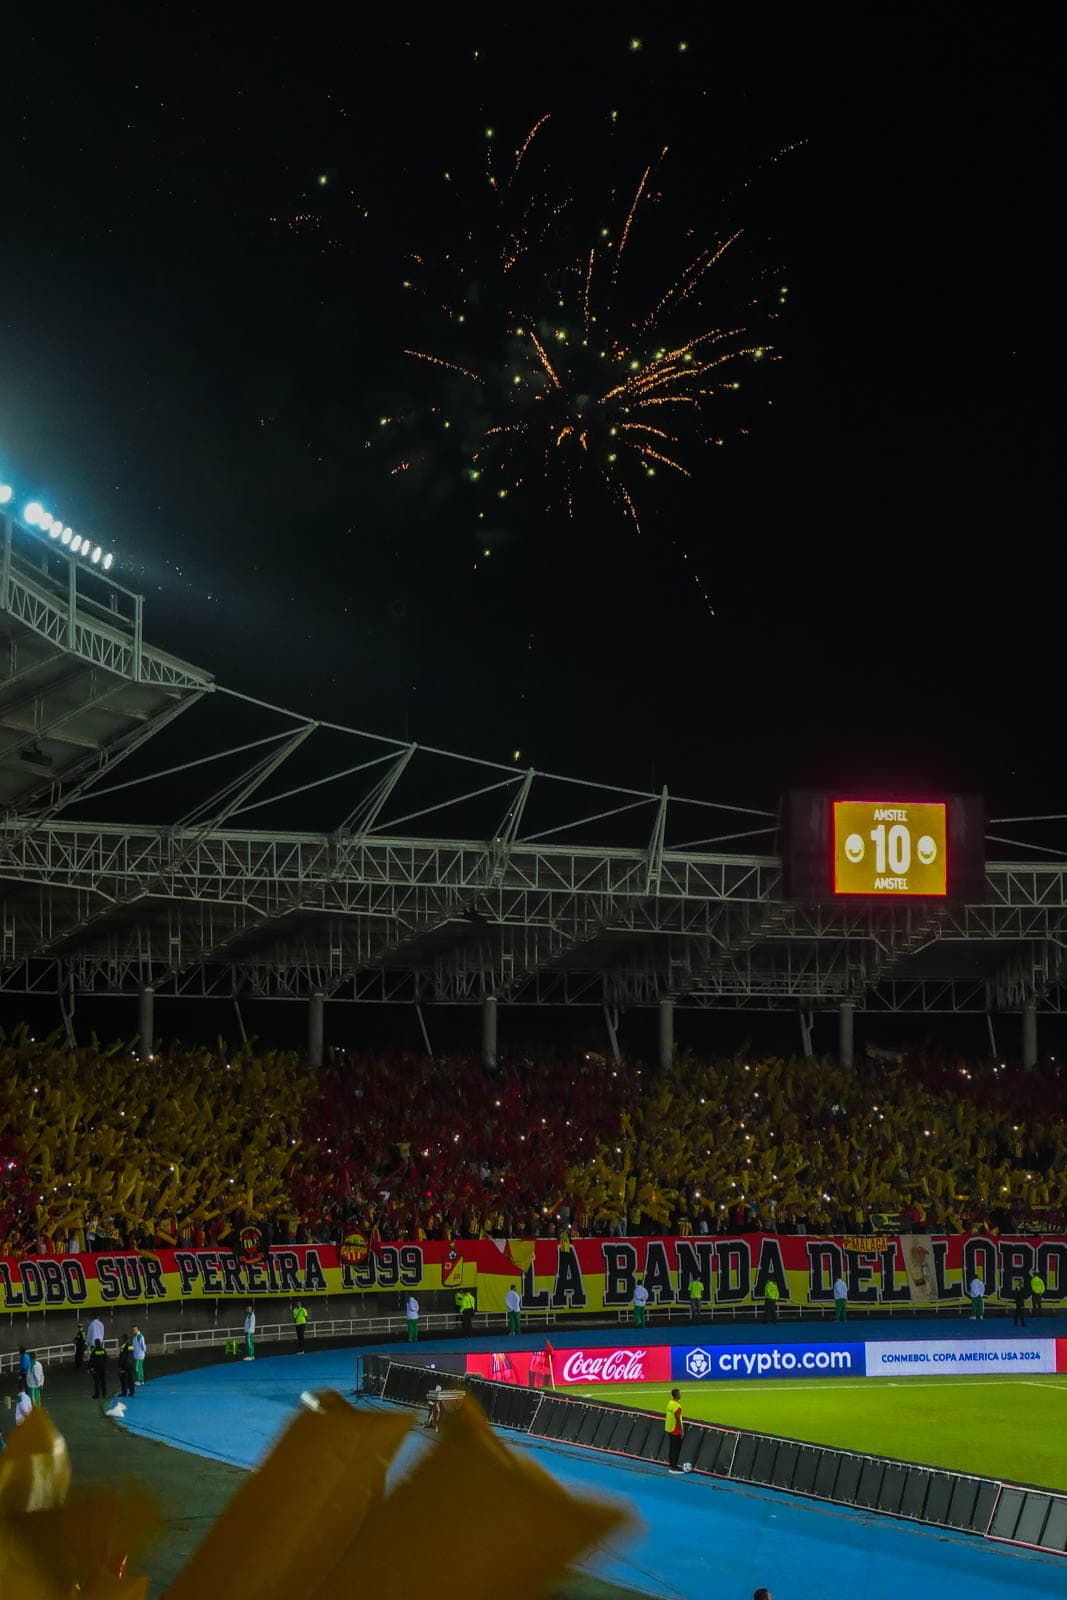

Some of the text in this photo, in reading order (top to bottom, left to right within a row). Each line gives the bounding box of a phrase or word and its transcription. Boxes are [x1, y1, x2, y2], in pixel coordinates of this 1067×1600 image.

[873, 809, 908, 822] AMSTEL
[870, 824, 911, 875] 10
[874, 878, 909, 890] AMSTEL
[0, 1245, 423, 1306] LOBO SUR PEREIRA 1999
[520, 1237, 1067, 1310] LA BANDA DEL LOBO
[563, 1350, 647, 1381] Coca-Cola
[719, 1349, 851, 1374] crypto.com
[881, 1352, 1041, 1363] CONMEBOL COPA AMERICA USA 2024
